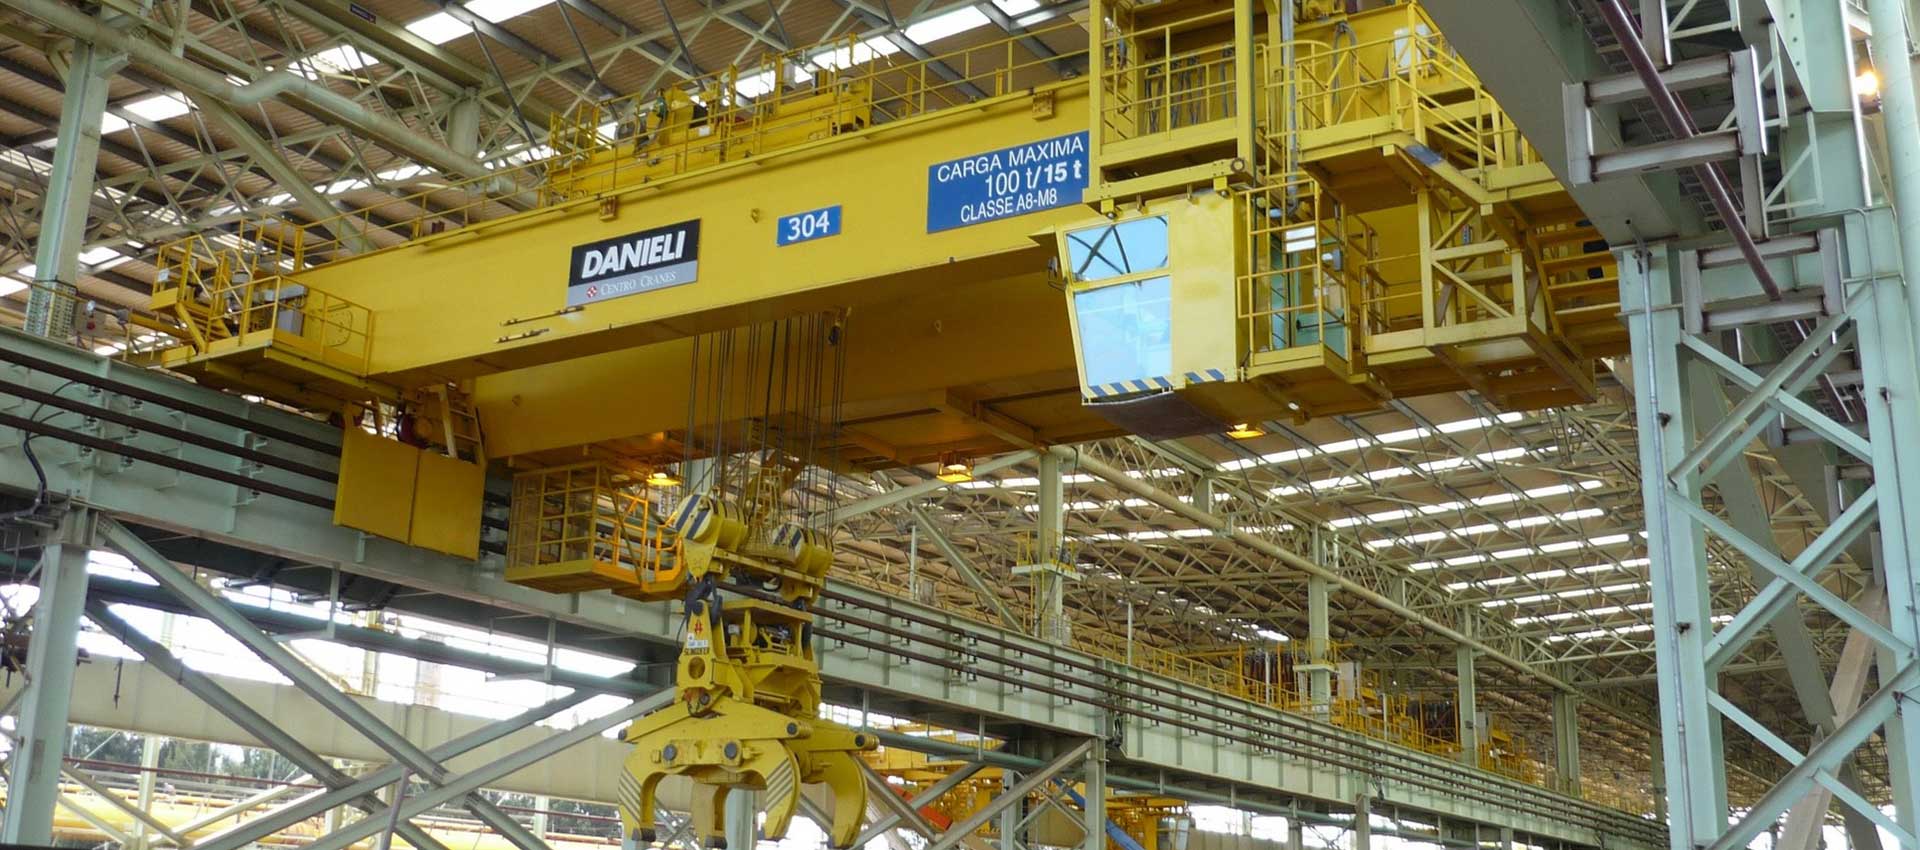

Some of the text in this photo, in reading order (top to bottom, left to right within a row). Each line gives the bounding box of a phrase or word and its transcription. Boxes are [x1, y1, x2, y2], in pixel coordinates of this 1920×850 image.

[937, 136, 1084, 182] CARGA MAXIMA
[985, 169, 1020, 198] 100
[1073, 159, 1082, 179] t
[960, 188, 1057, 223] CLASSE A8-M8
[787, 210, 830, 241] 304
[581, 230, 686, 279] DANIELI
[600, 279, 637, 296] CENTRO
